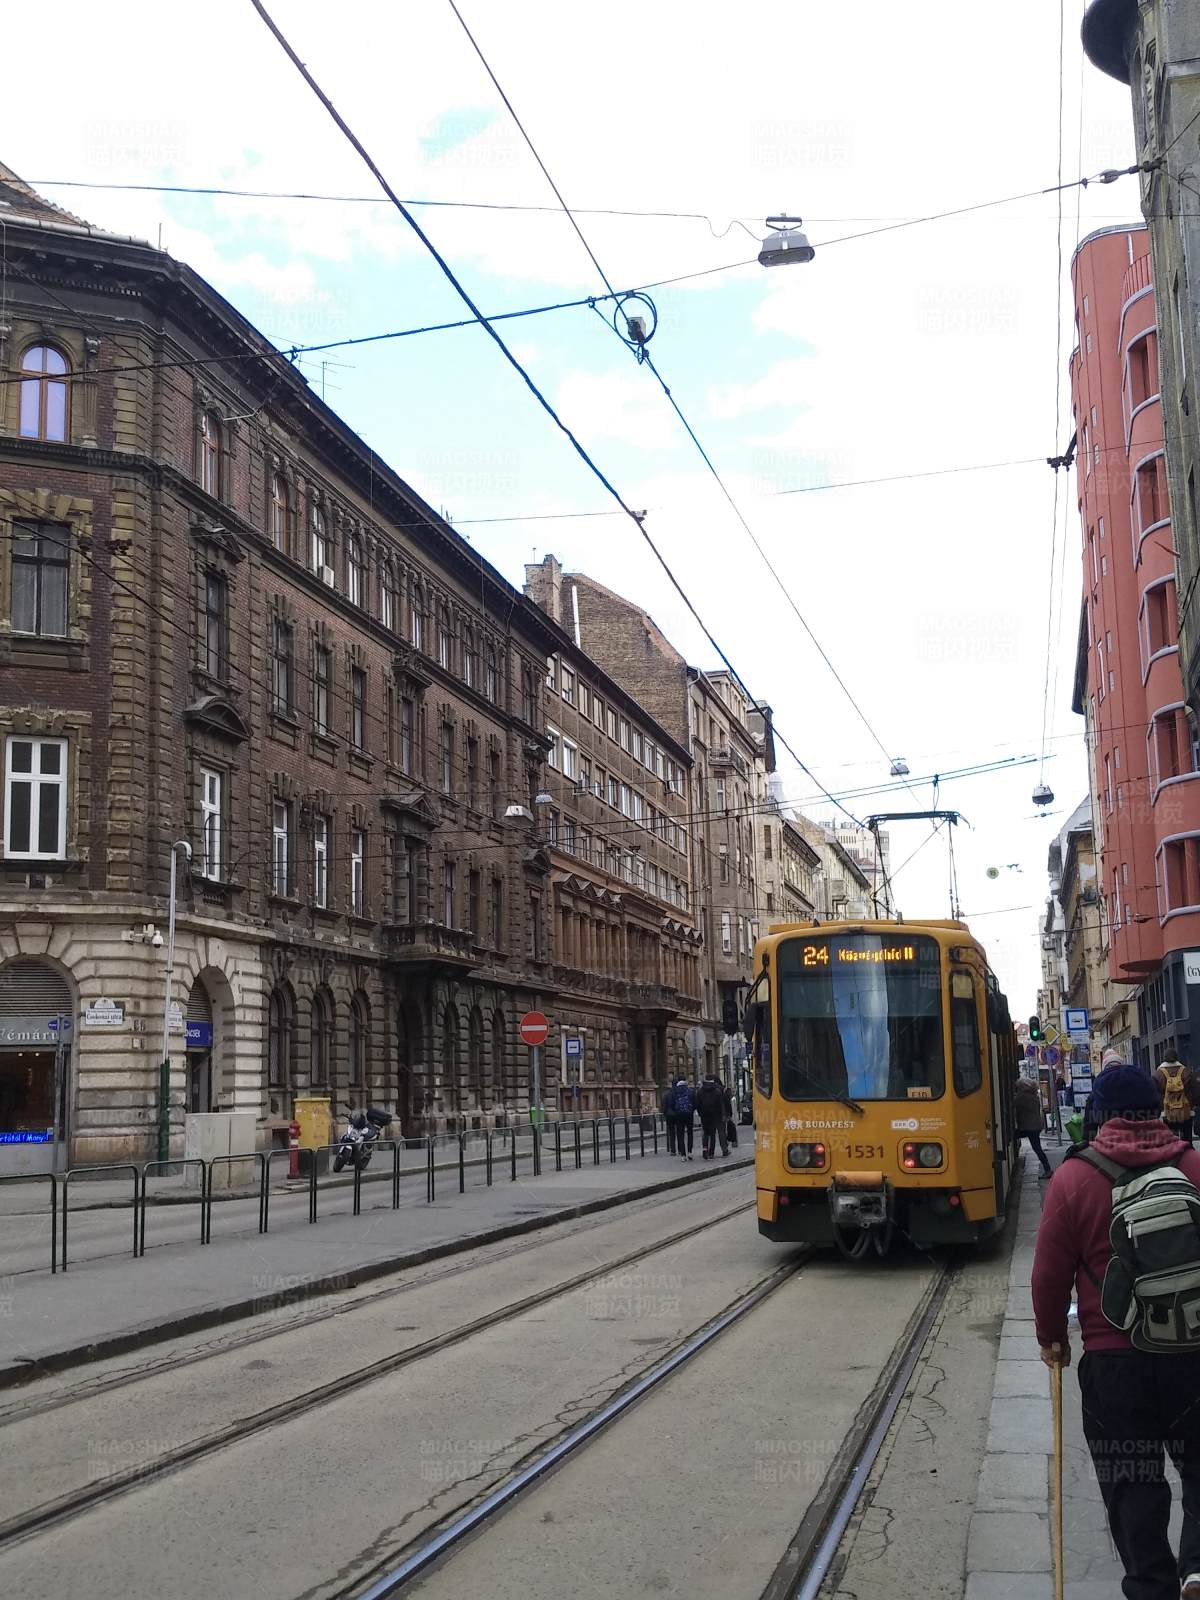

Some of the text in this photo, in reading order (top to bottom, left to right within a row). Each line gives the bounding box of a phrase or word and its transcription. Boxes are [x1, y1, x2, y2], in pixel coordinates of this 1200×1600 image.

[803, 946, 829, 965] 24
[805, 1120, 856, 1129] BUDAPEST
[845, 1145, 884, 1158] 1531
